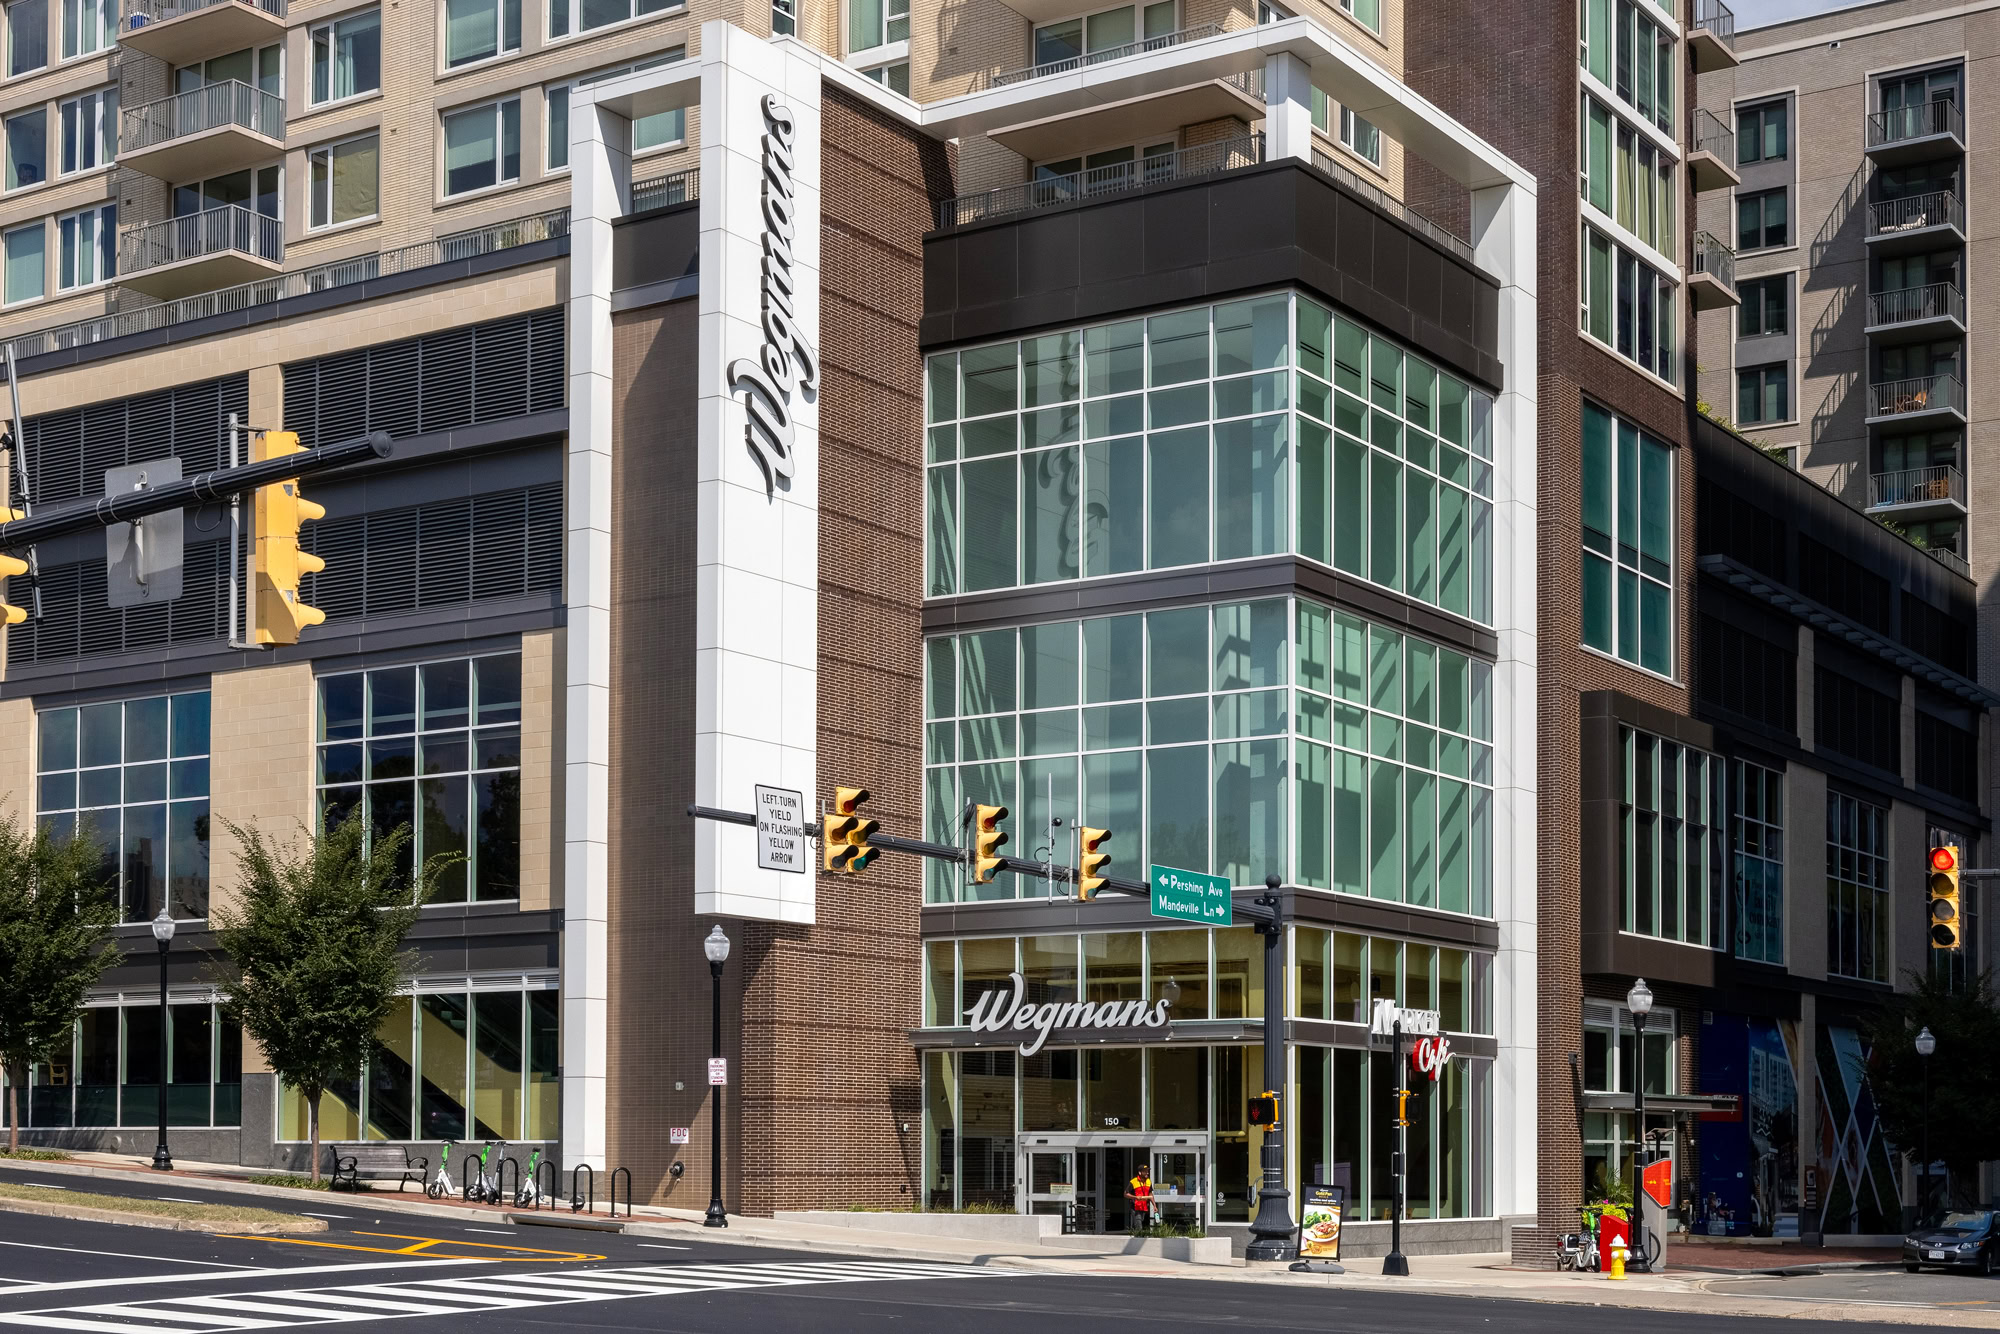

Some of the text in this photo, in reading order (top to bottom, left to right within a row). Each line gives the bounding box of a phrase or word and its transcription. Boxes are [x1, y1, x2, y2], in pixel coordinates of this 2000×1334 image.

[727, 93, 820, 506] Wegmans
[762, 793, 797, 808] LEFT TURN
[769, 808, 792, 821] YIELD
[760, 821, 802, 837] ON FLASHING
[769, 837, 794, 850] YELLOW
[770, 851, 793, 864] ARROW
[1170, 874, 1223, 897] Pershing Ave
[1159, 894, 1214, 917] Mandeville Ln
[962, 972, 1170, 1057] Wegmans
[1104, 1117, 1119, 1126] 150
[672, 1128, 687, 1137] FDC
[1163, 1154, 1168, 1164] 3
